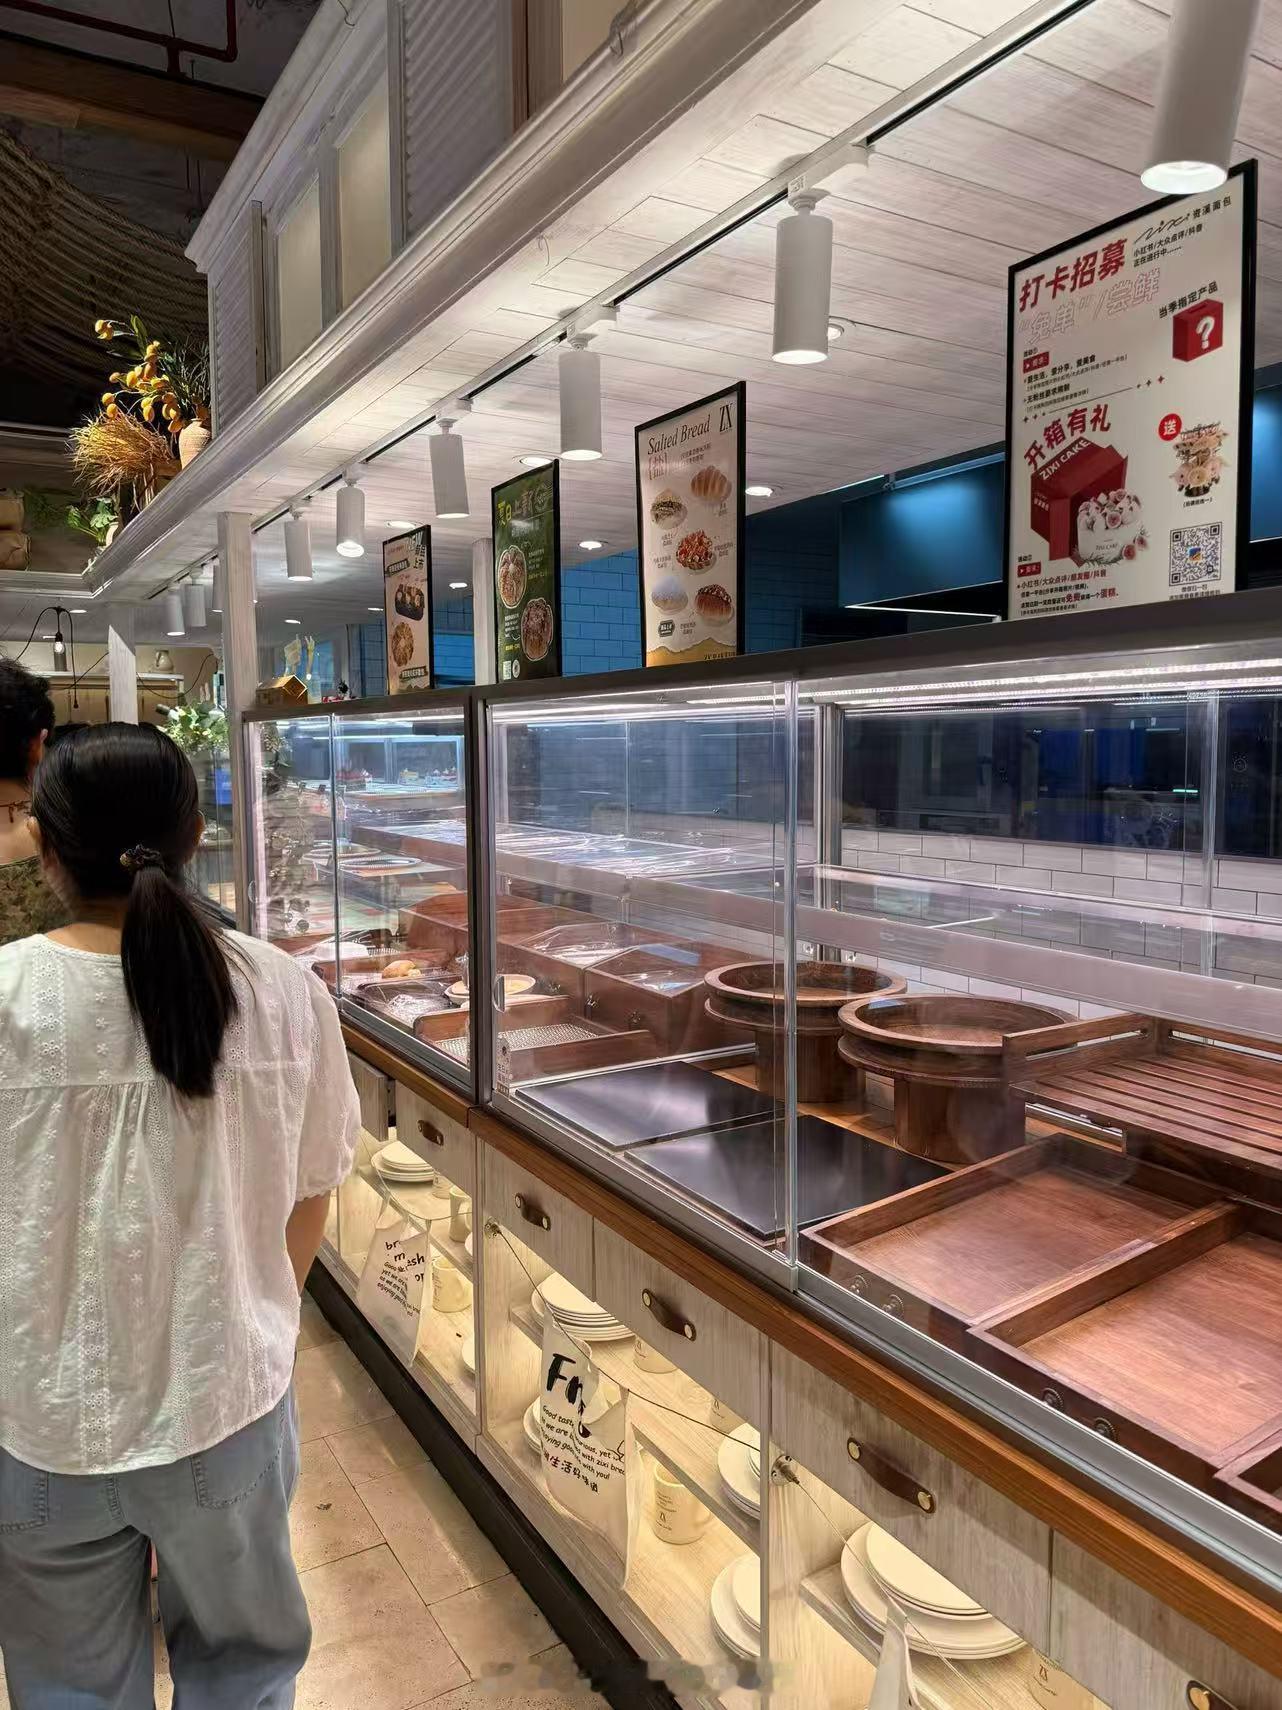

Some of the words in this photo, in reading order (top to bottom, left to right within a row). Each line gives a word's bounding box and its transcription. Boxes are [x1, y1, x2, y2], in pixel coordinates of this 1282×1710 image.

[1019, 238, 1128, 313] 打卡招募
[1160, 281, 1218, 319] 当季指定产品
[648, 428, 679, 455] Salted
[680, 414, 711, 443] Bread
[1023, 404, 1111, 472] 开箱有礼
[1163, 419, 1177, 436] 送
[1040, 461, 1061, 480] ZIXI
[1060, 440, 1092, 463] CAKE
